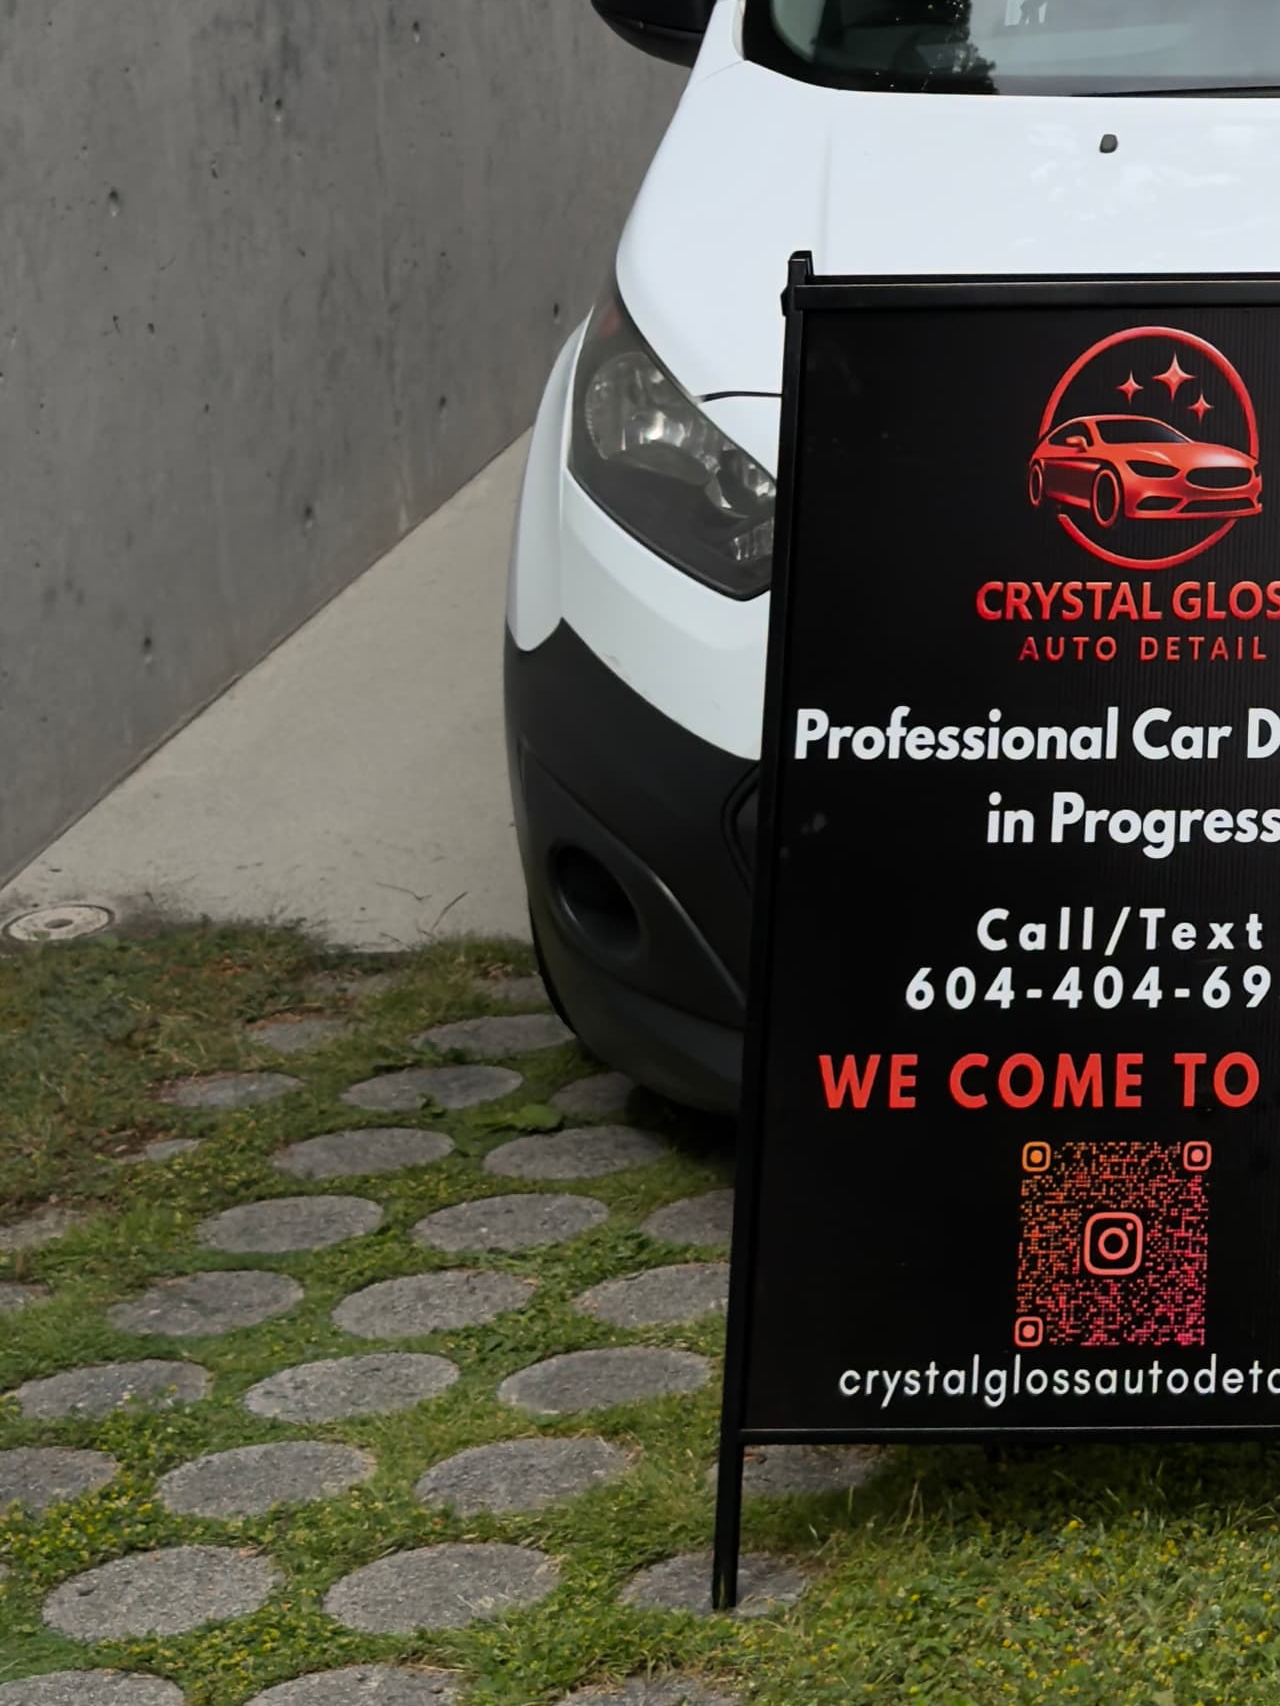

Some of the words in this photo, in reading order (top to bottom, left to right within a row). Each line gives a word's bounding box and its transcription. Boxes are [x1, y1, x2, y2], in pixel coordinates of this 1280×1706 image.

[974, 580, 1164, 622] CRYSTAL
[1018, 635, 1118, 662] AUTO
[1138, 635, 1268, 662] DETAIL
[793, 705, 1120, 762] Professional
[1131, 706, 1234, 761] Car
[986, 790, 1036, 845] in
[975, 905, 1264, 957] Call/Text
[817, 1052, 919, 1110] WE
[948, 1051, 1145, 1110] COME
[1172, 1050, 1261, 1109] TO
